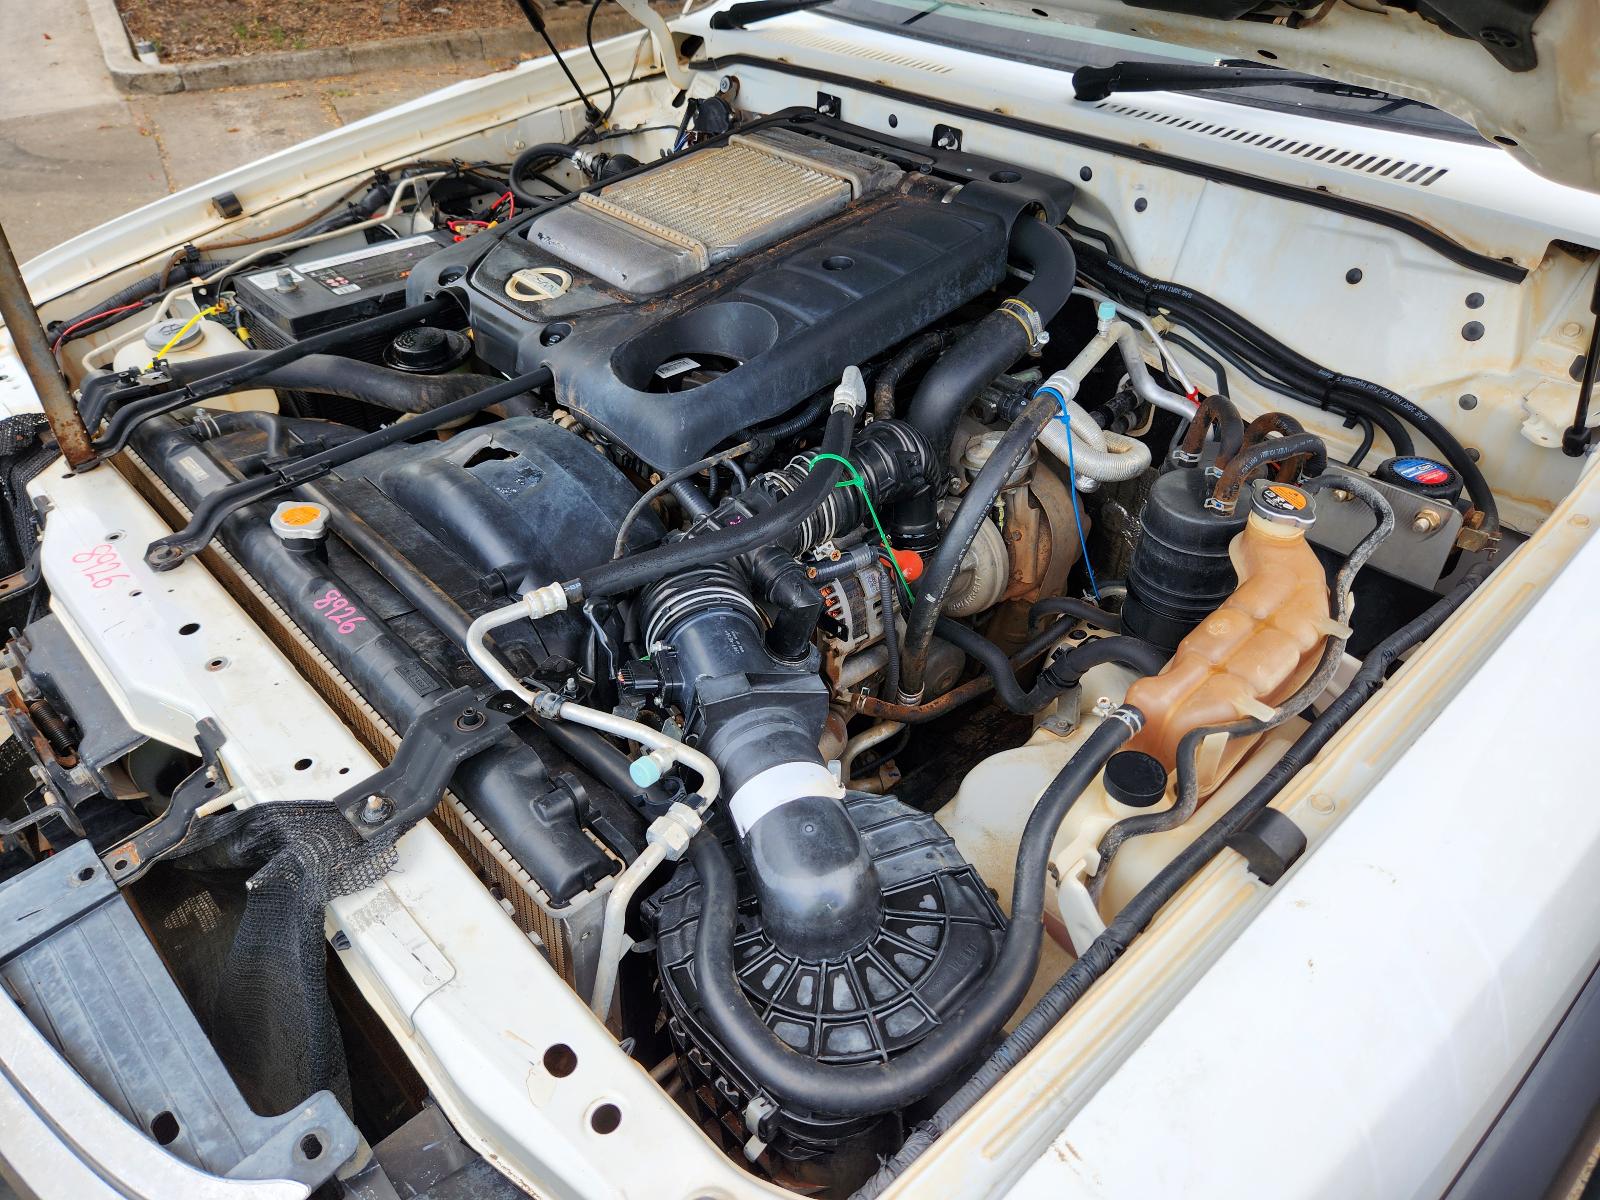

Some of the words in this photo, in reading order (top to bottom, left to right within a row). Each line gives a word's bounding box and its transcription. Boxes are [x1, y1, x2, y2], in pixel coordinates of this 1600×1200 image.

[1342, 377, 1367, 389] Injection
[1367, 384, 1380, 394] Fuel
[1415, 411, 1428, 421] SAE
[72, 543, 130, 589] 8926
[313, 589, 367, 635] 8926
